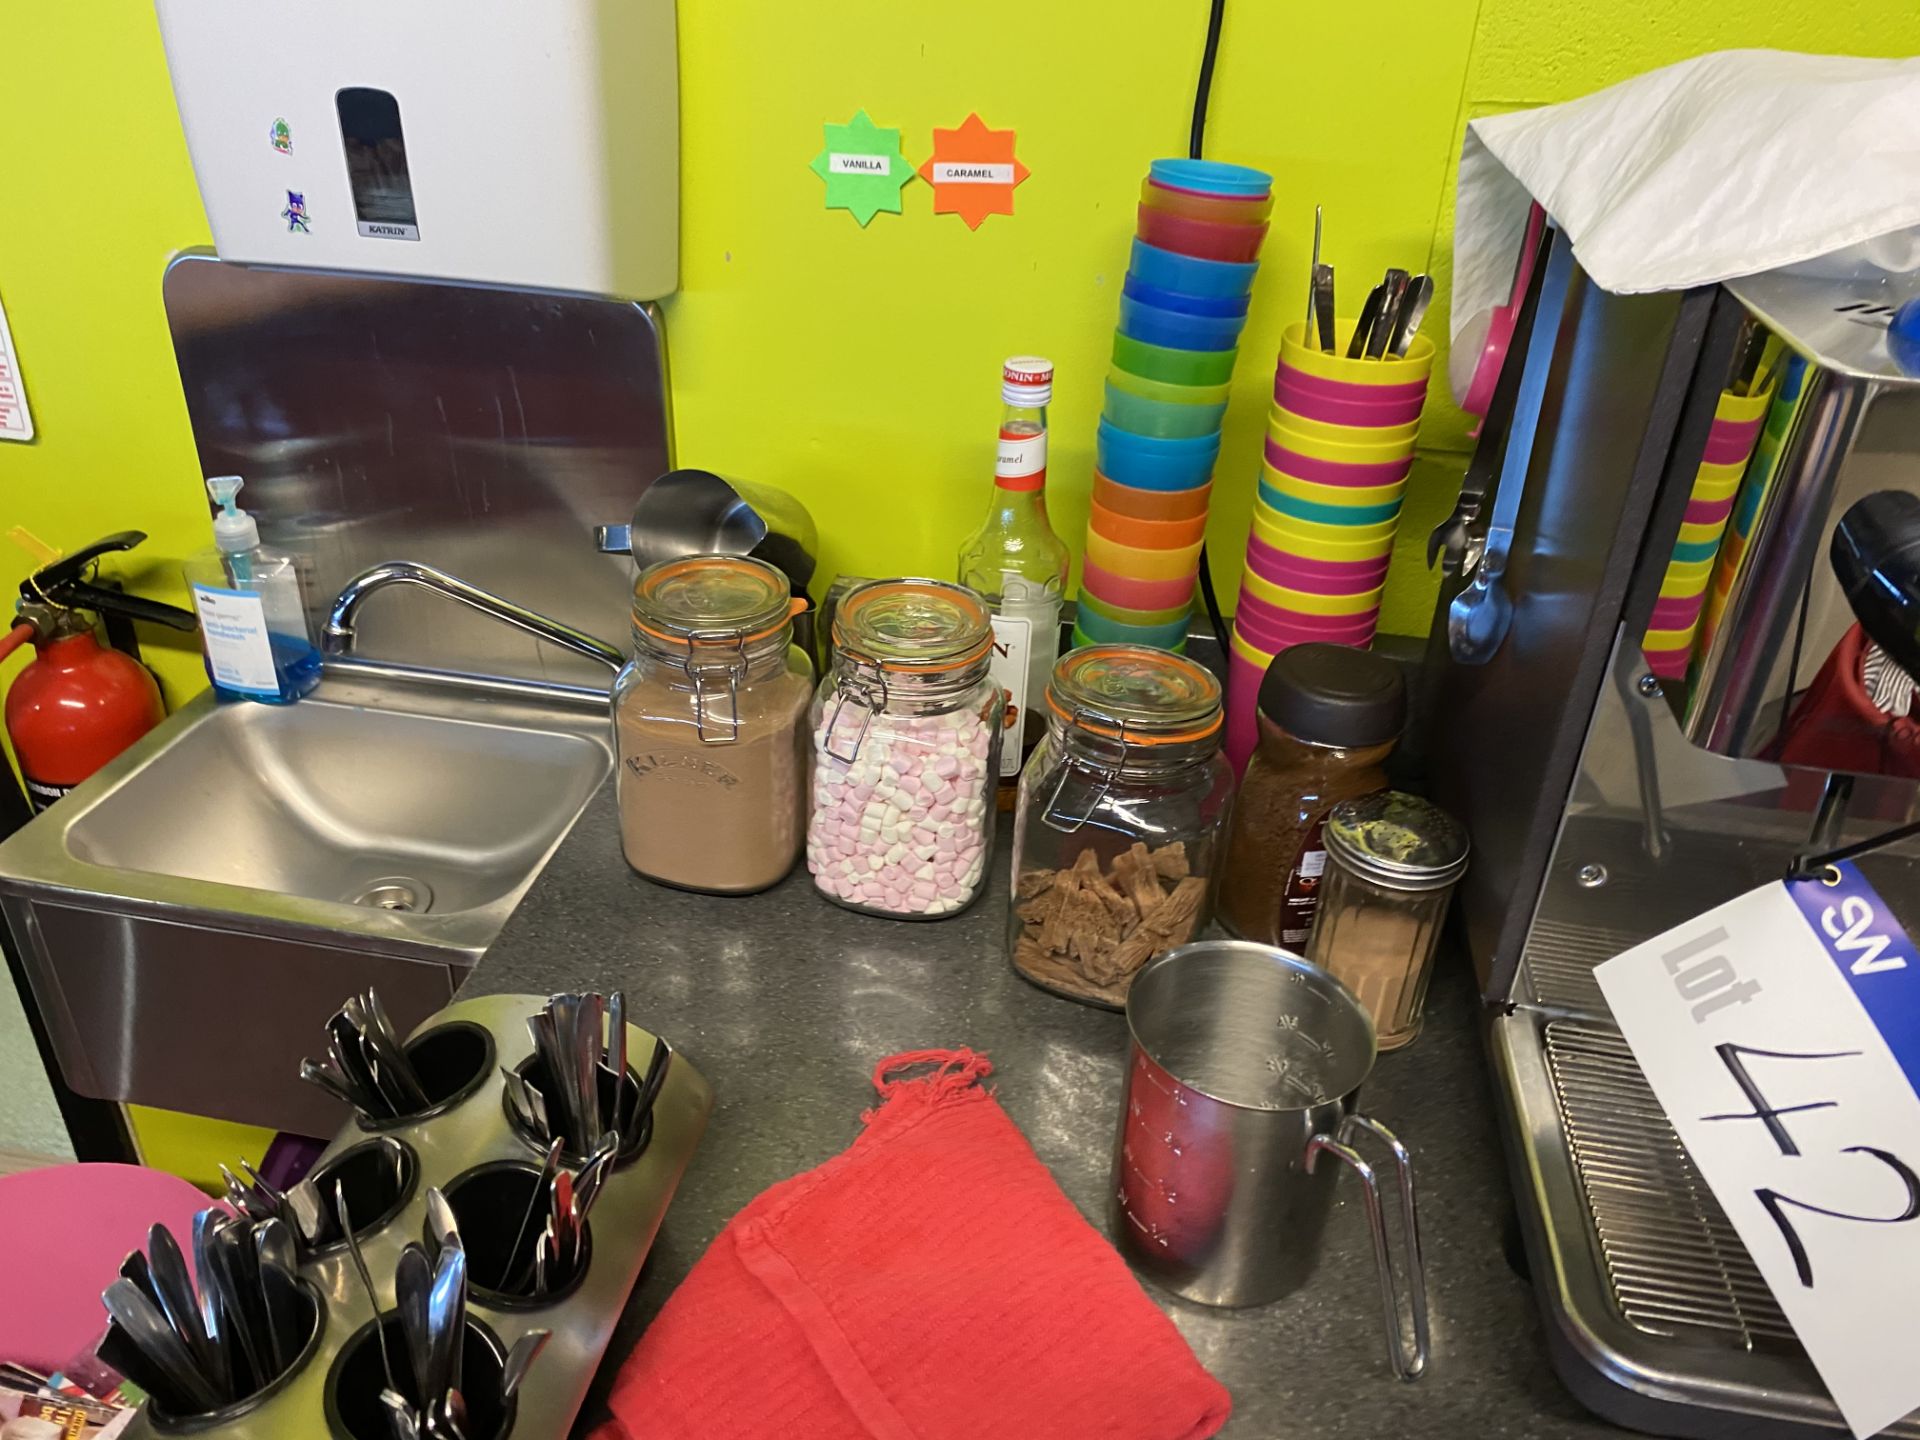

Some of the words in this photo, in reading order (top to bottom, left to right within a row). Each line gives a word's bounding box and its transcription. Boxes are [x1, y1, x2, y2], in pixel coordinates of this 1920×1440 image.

[842, 159, 882, 171] VANILLA
[946, 168, 994, 179] CARAMEL
[368, 225, 406, 236] KATRIN
[1004, 369, 1034, 383] ONIN
[1660, 926, 1763, 1025] Lot
[1699, 1042, 1920, 1290] 42
